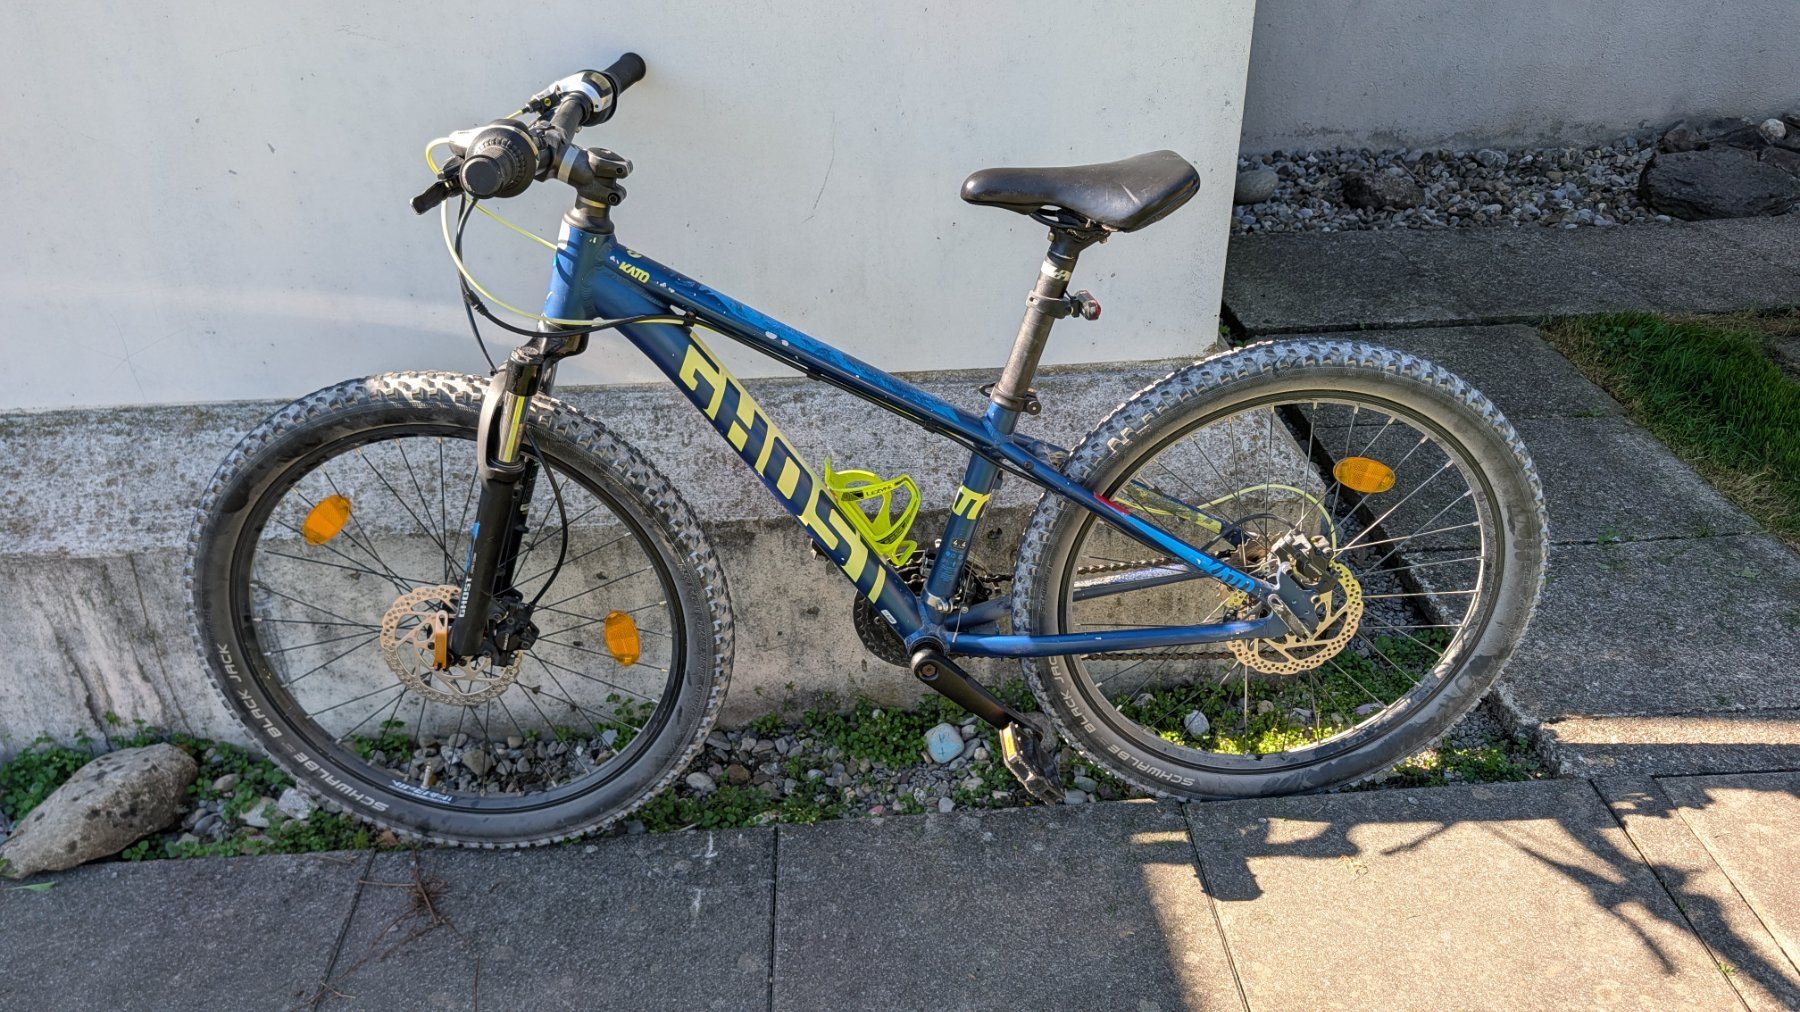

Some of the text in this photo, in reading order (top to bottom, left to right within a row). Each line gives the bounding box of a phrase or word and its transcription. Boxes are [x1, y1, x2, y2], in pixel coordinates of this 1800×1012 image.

[618, 261, 650, 283] KATO
[678, 331, 887, 604] GHOST
[459, 575, 473, 618] GHOST
[216, 643, 389, 812] SCHWALBE BLACK JACK
[1049, 656, 1196, 787] SCHWALBE BLACK JAC
